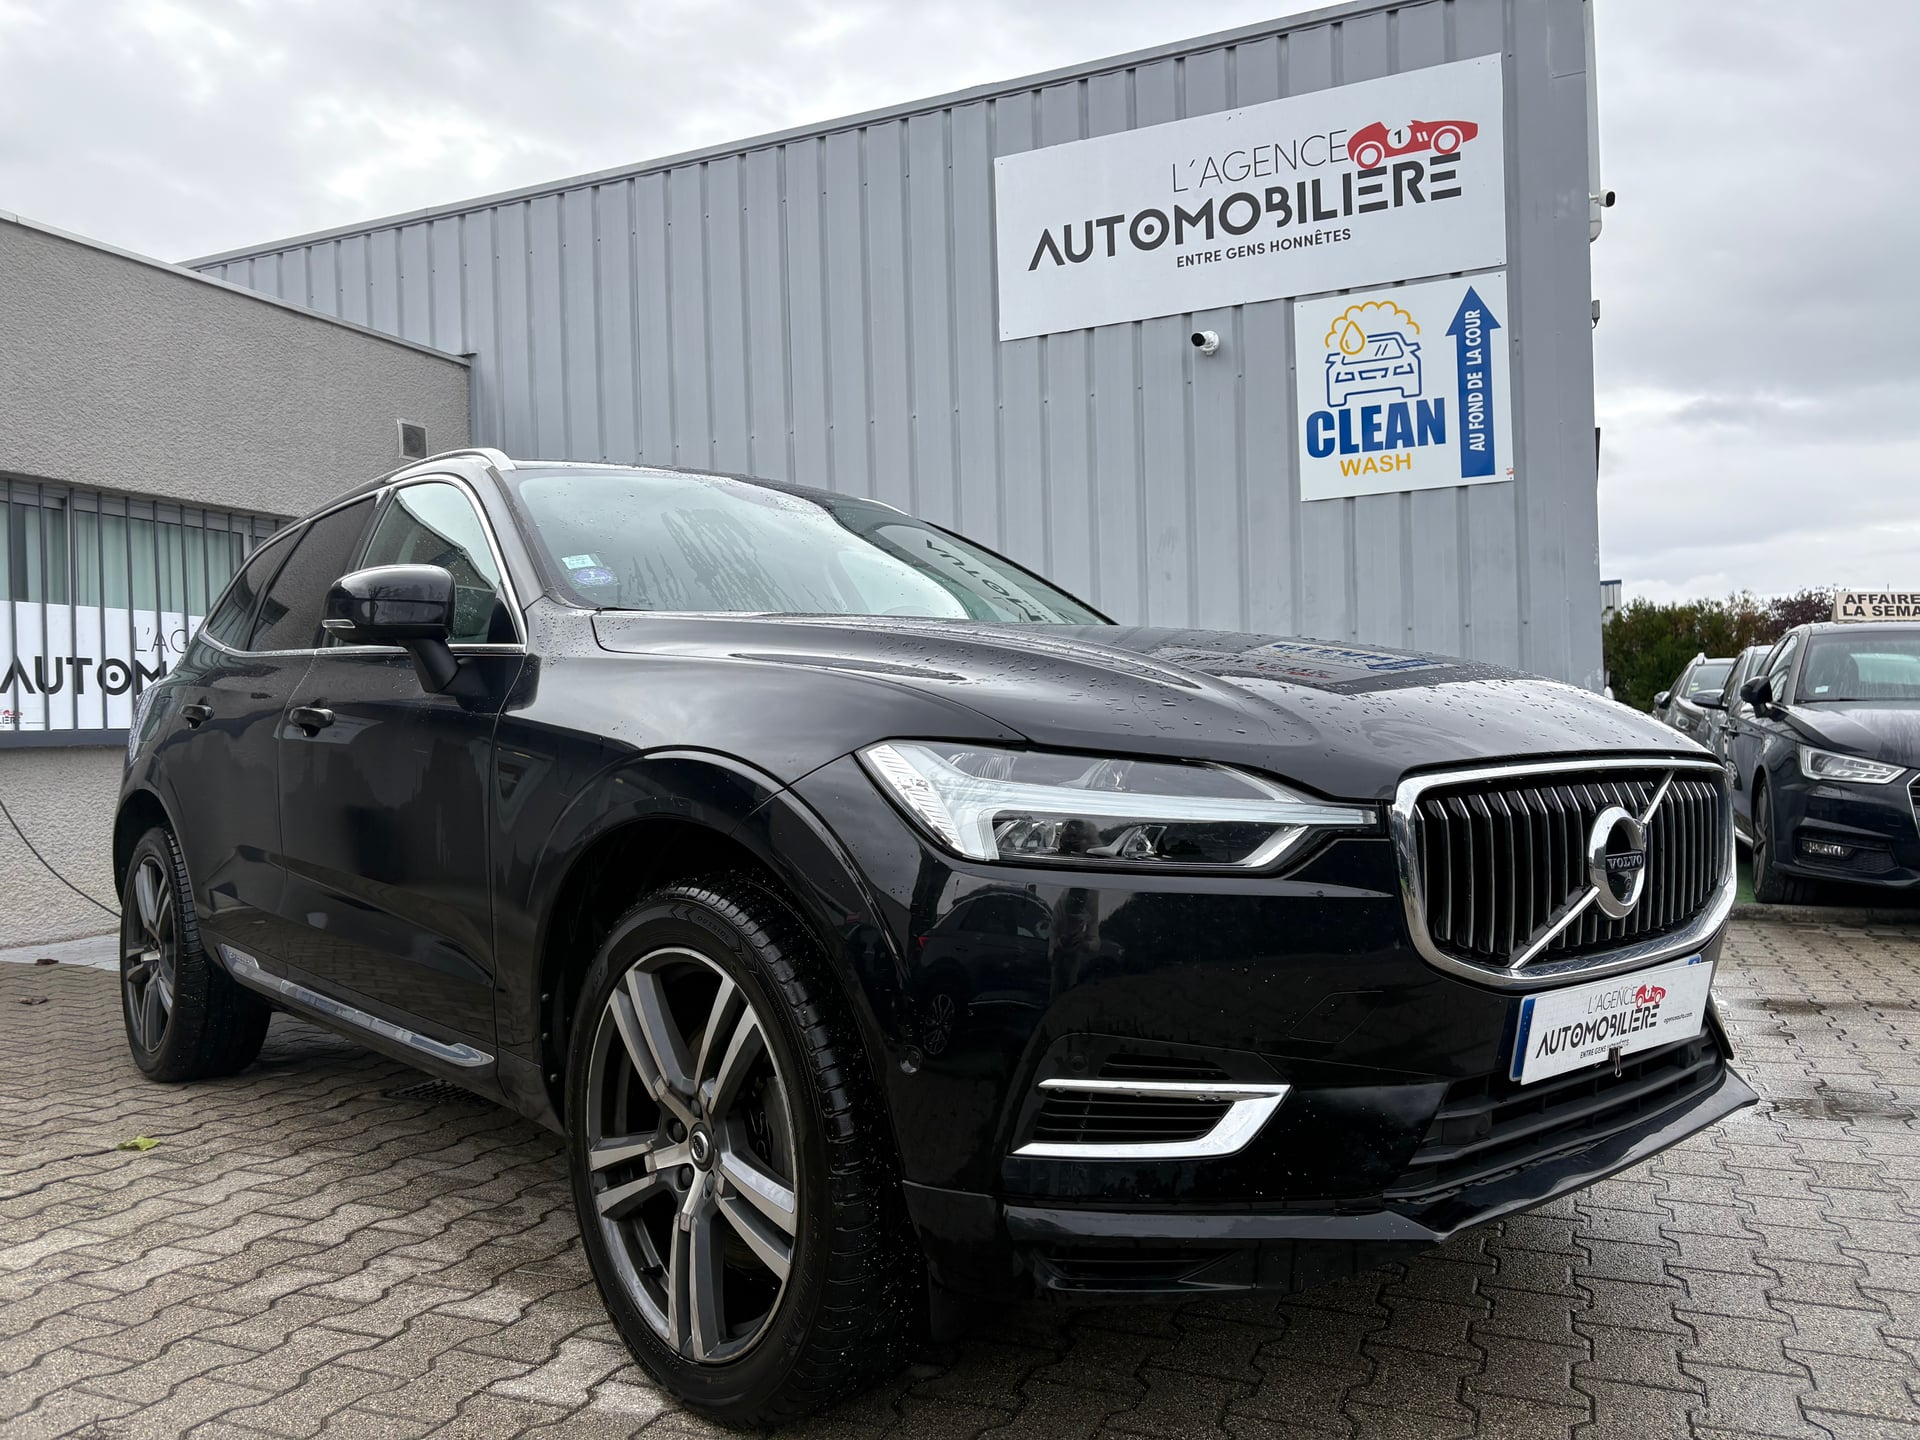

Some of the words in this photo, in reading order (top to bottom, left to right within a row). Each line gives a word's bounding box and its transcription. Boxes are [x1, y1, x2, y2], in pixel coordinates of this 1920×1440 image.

[1394, 129, 1401, 144] 1
[1171, 129, 1348, 193] L'AGENCE
[1176, 250, 1222, 268] ENTRE
[1226, 242, 1265, 260] GENS
[1270, 228, 1351, 255] HONNÊTES
[1465, 309, 1482, 346] COUR
[1466, 348, 1482, 365] LA
[1467, 371, 1483, 389] DE
[1468, 392, 1484, 430] FOND
[1306, 397, 1446, 458] CLEAN
[1469, 433, 1485, 451] AU
[1339, 453, 1412, 477] WASH
[1844, 594, 1920, 605] AFFAIRE
[1842, 605, 1866, 616] LA
[1607, 855, 1642, 869] VOLVO
[1587, 985, 1638, 1014] L'AGENCE
